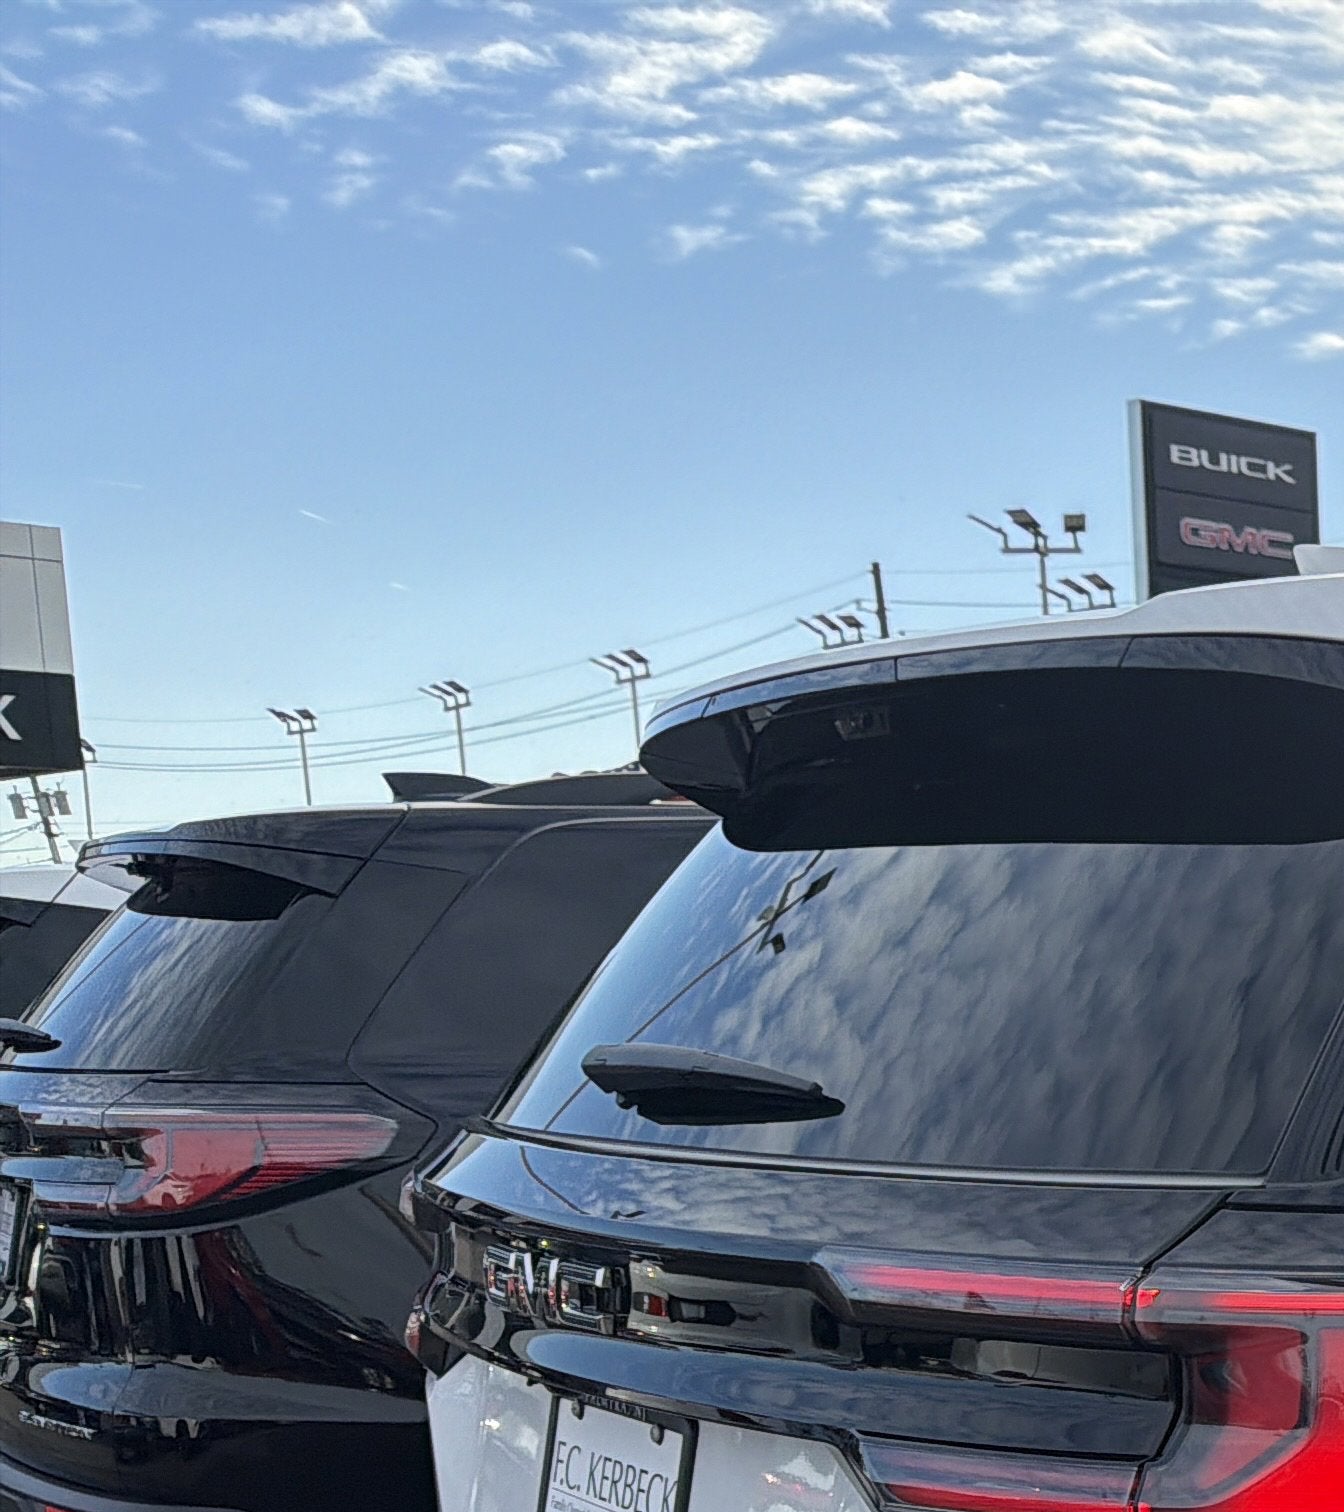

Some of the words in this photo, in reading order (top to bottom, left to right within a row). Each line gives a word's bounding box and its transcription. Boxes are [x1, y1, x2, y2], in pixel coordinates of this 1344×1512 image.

[1169, 443, 1297, 485] BUICK
[1179, 516, 1295, 560] GMC
[553, 1440, 581, 1492] F.C.
